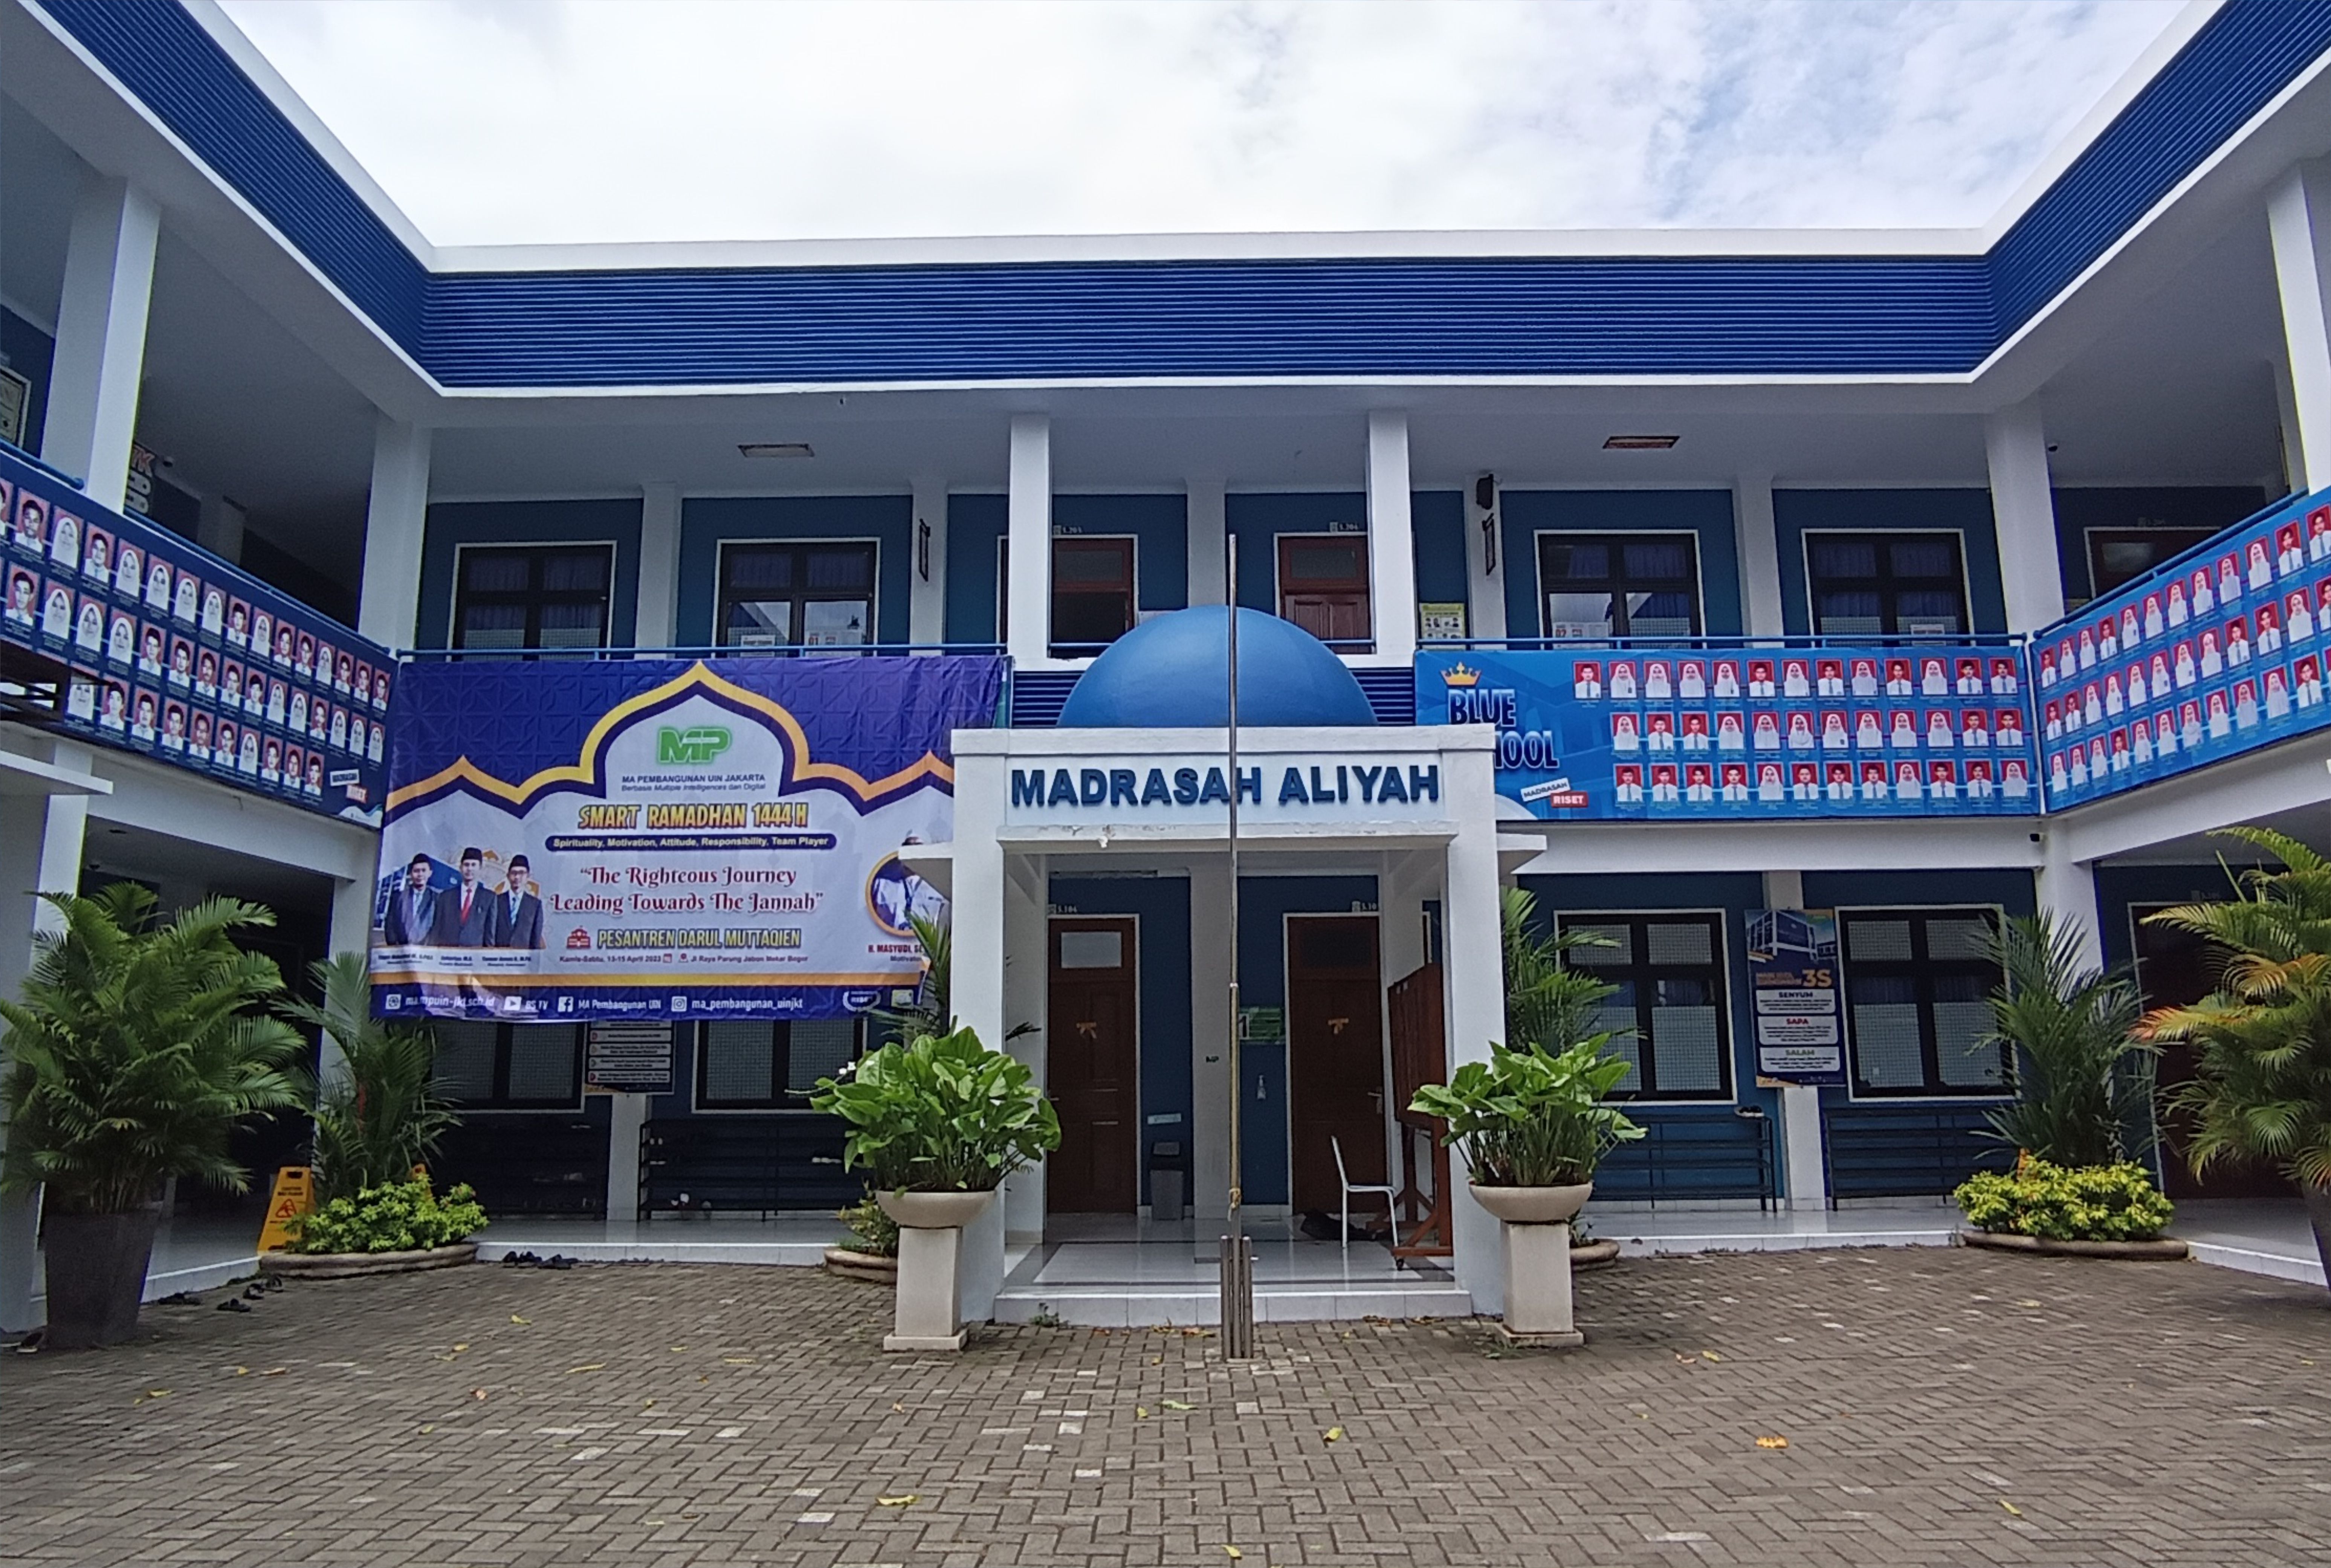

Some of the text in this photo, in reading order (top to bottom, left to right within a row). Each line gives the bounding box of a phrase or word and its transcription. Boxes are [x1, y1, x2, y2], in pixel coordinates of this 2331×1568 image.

[1448, 689, 1516, 727] BLUE
[659, 728, 730, 763] MP
[1011, 765, 1439, 806] MADRASAH ALIYAH
[1524, 782, 1567, 797] MADRASAH
[1553, 795, 1584, 804] RISET
[579, 802, 808, 829] SMART RAMADHAN 1444 H
[553, 836, 828, 849] Spirituality, Motivation, Attitude, Responsibility, Team Player
[625, 867, 717, 889] Righteous
[722, 866, 796, 886] Journey
[550, 893, 624, 914] Leading
[628, 892, 704, 911] Towards
[709, 893, 743, 911] The
[597, 929, 800, 948] PESANTREN DARUL MUTTAQIEN
[1802, 969, 1832, 987] 3S
